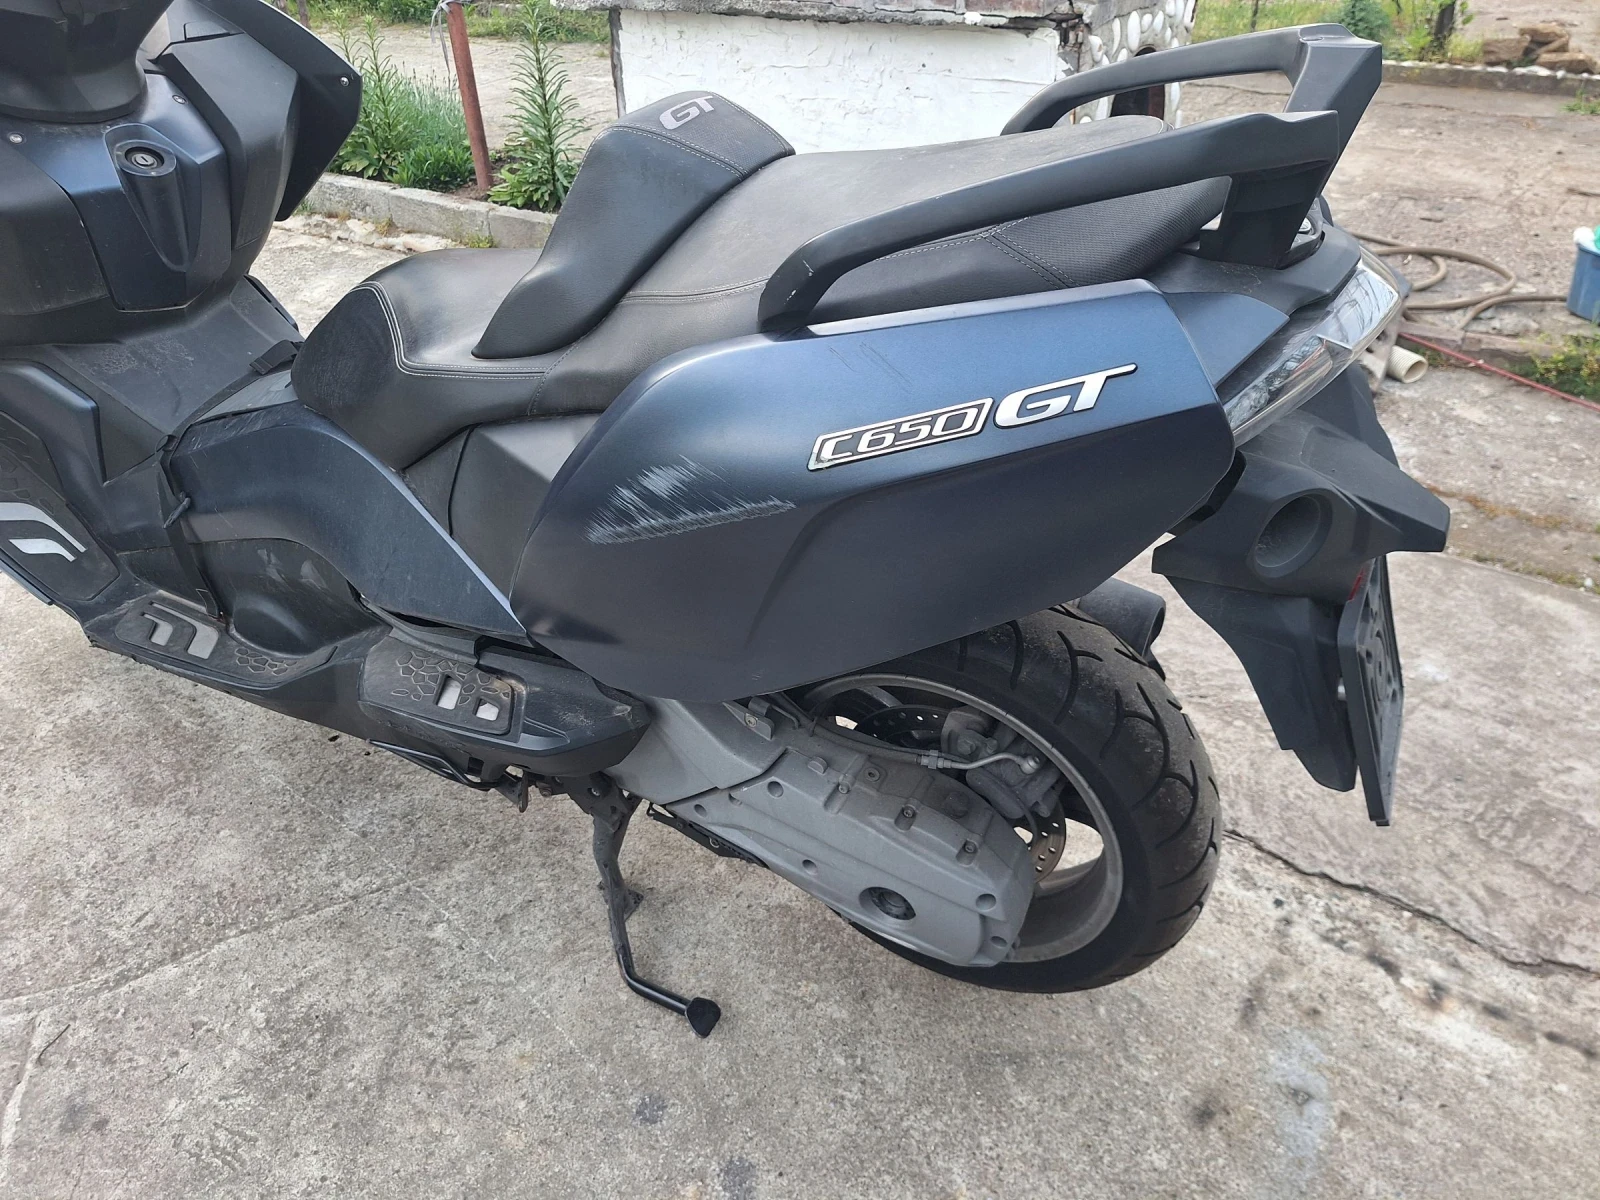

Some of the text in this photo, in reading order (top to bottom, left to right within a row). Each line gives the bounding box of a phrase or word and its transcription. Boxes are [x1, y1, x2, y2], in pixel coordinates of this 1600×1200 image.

[659, 95, 715, 130] GT
[817, 363, 1137, 461] C650 GT
